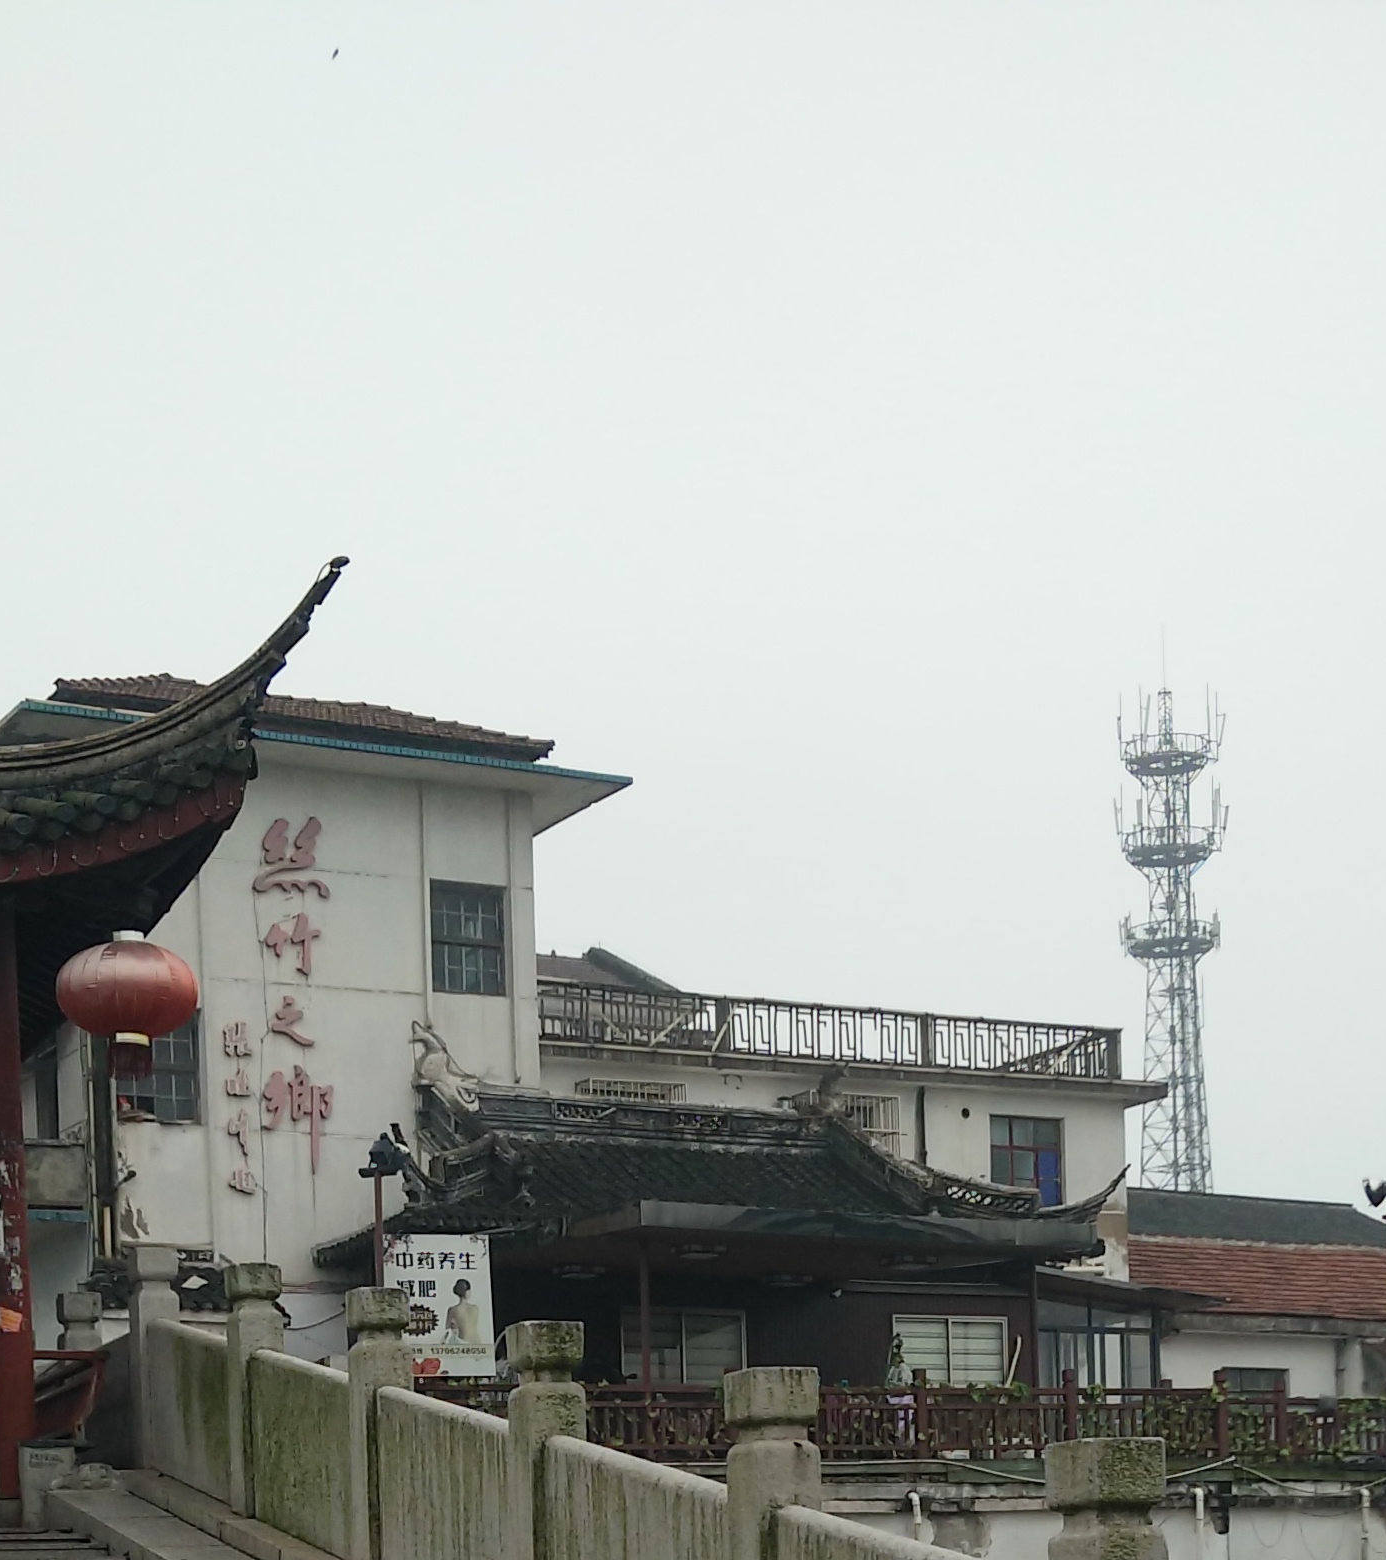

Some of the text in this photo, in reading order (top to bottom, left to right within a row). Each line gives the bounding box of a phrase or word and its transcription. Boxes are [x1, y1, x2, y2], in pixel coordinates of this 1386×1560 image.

[396, 1251, 477, 1269] 中药养生
[397, 1280, 436, 1297] 减肥
